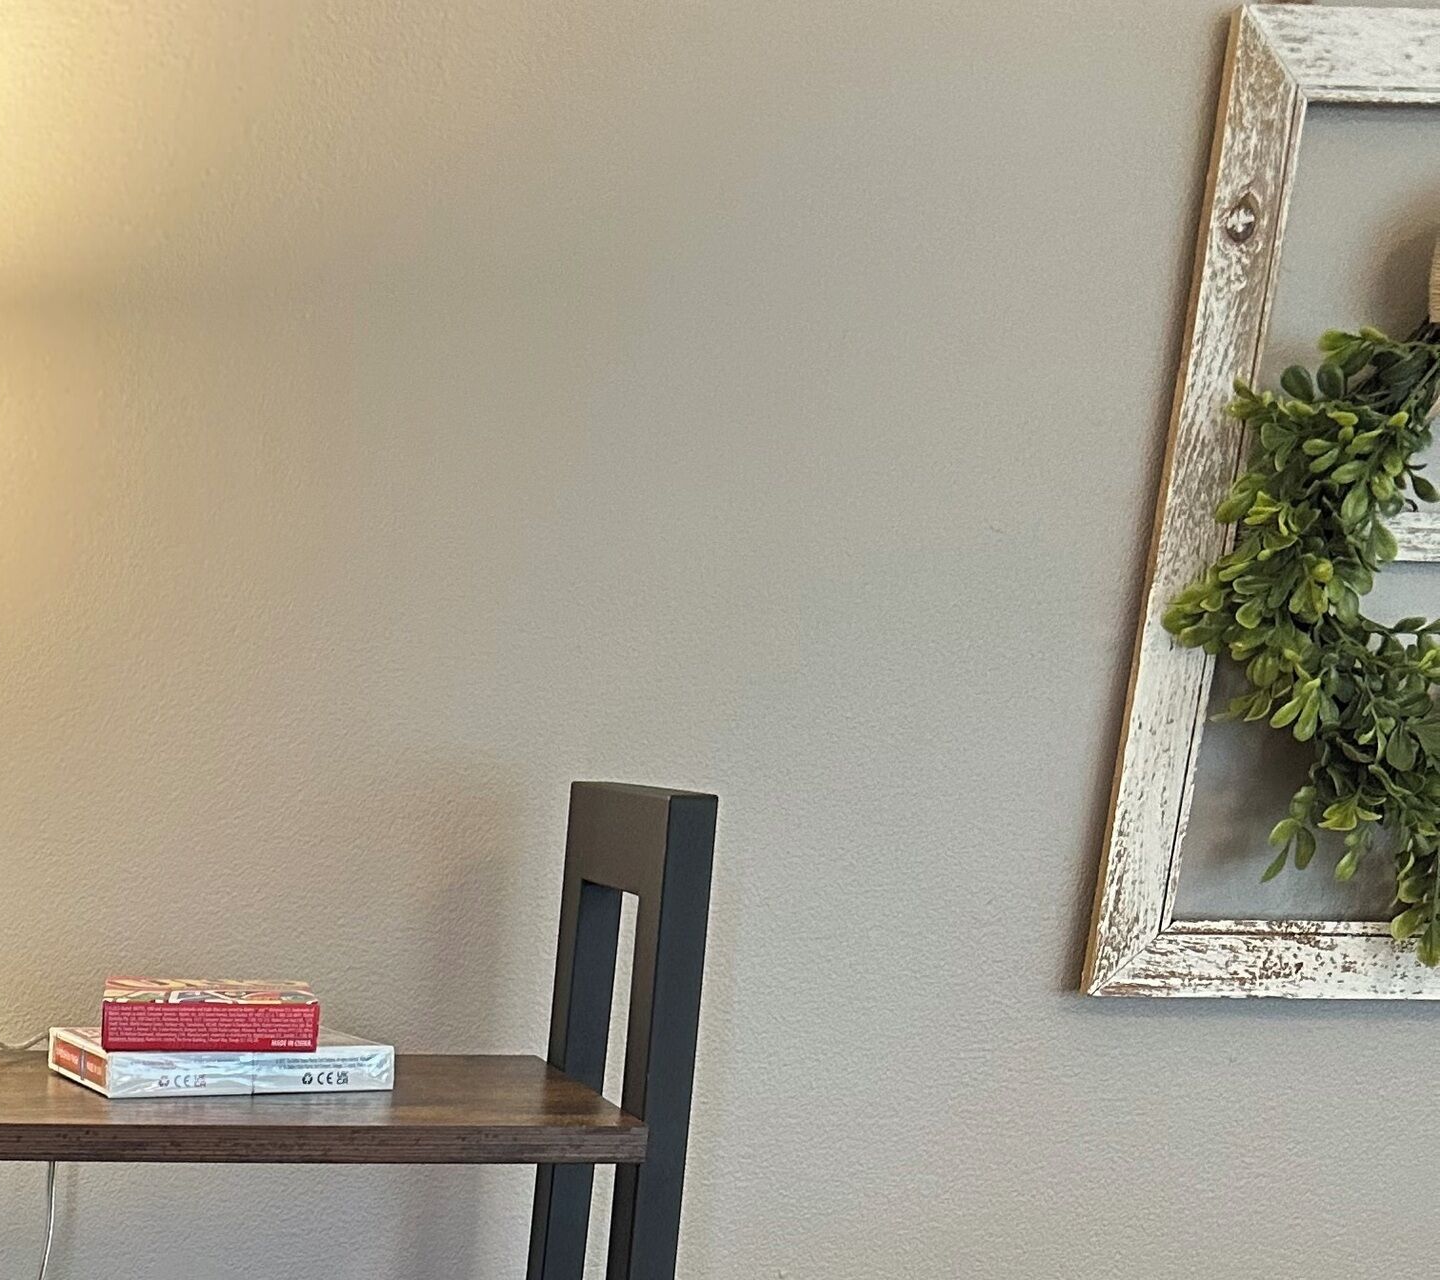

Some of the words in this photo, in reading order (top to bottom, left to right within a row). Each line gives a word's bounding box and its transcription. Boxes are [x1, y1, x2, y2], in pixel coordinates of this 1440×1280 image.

[271, 1039, 287, 1047] MADE
[287, 1039, 294, 1047] IN
[317, 1071, 334, 1085] CE
